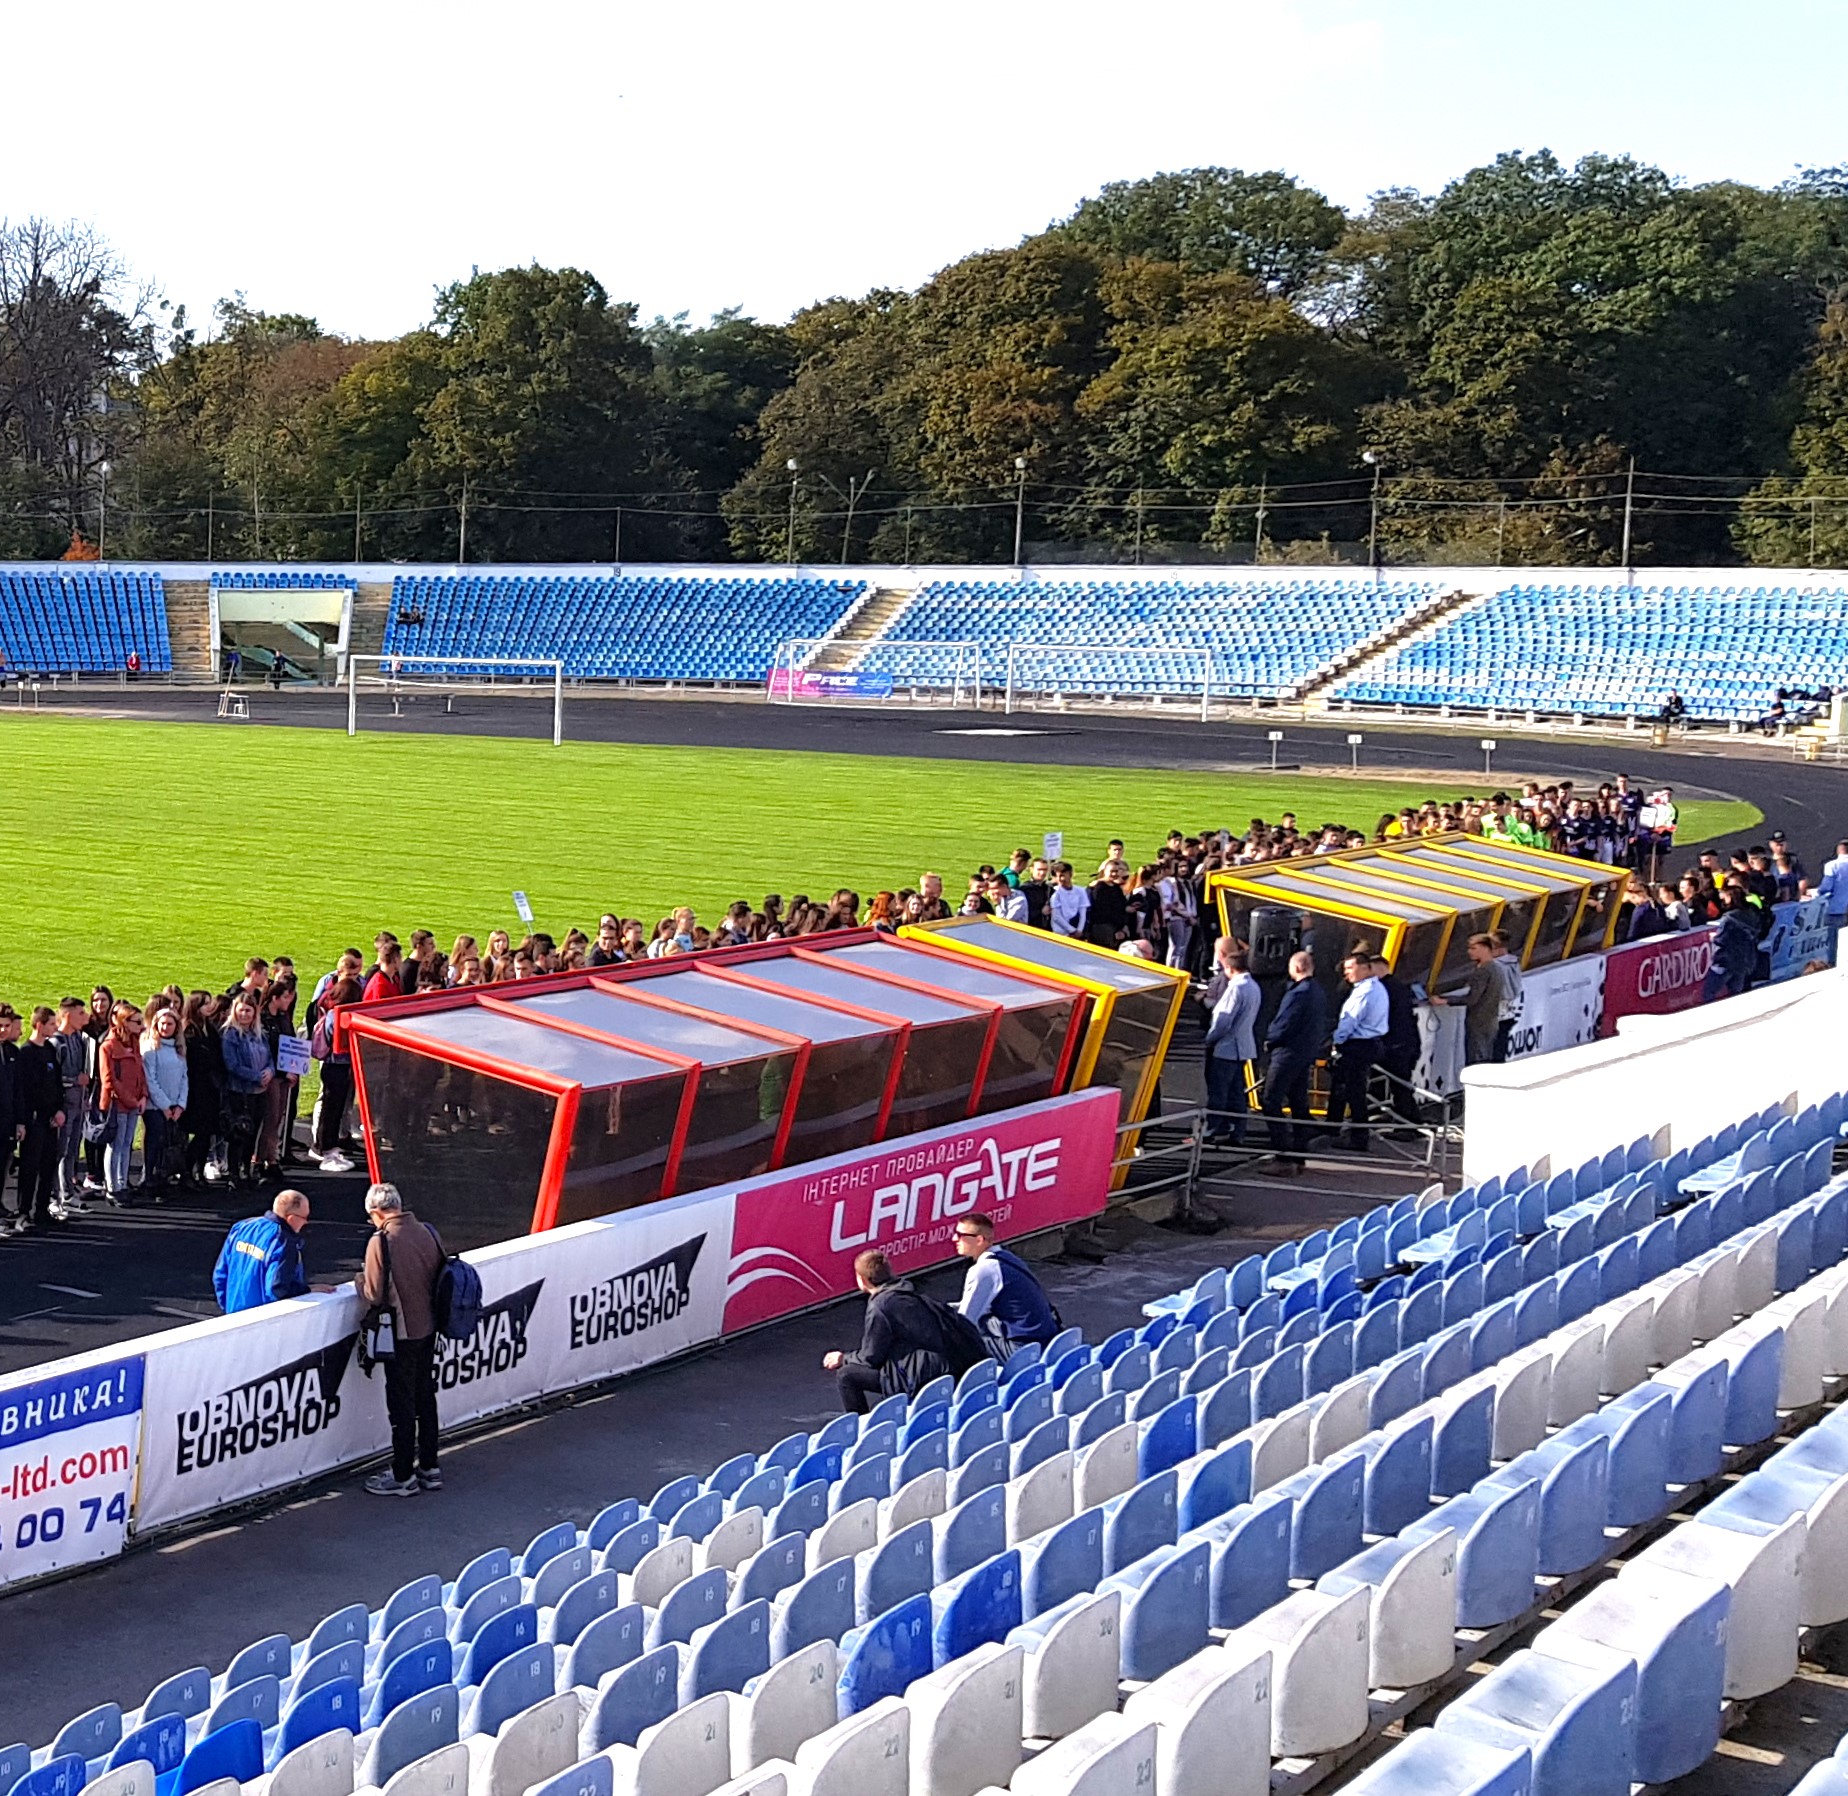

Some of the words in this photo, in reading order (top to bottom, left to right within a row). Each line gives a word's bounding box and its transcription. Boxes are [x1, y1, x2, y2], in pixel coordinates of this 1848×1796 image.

[803, 1164, 880, 1203] ІНТЕРНЕТ
[885, 1138, 975, 1178] ПРОВАЙДЕР
[830, 1137, 1061, 1252] LANGATE
[571, 1262, 677, 1320] OBNOVA
[434, 1310, 512, 1355] NOVA
[570, 1286, 689, 1350] EUROSHOP
[179, 1368, 322, 1440] OBNOVA
[177, 1396, 340, 1475] EUROSHOP
[16, 1507, 64, 1549] 00
[80, 1491, 127, 1535] 74
[515, 1623, 525, 1637] 16
[427, 1658, 437, 1672] 17
[530, 1661, 540, 1676] 18
[655, 1667, 666, 1684] 19
[332, 1695, 342, 1710] 18
[431, 1708, 442, 1723] 19
[705, 1723, 716, 1741] 21
